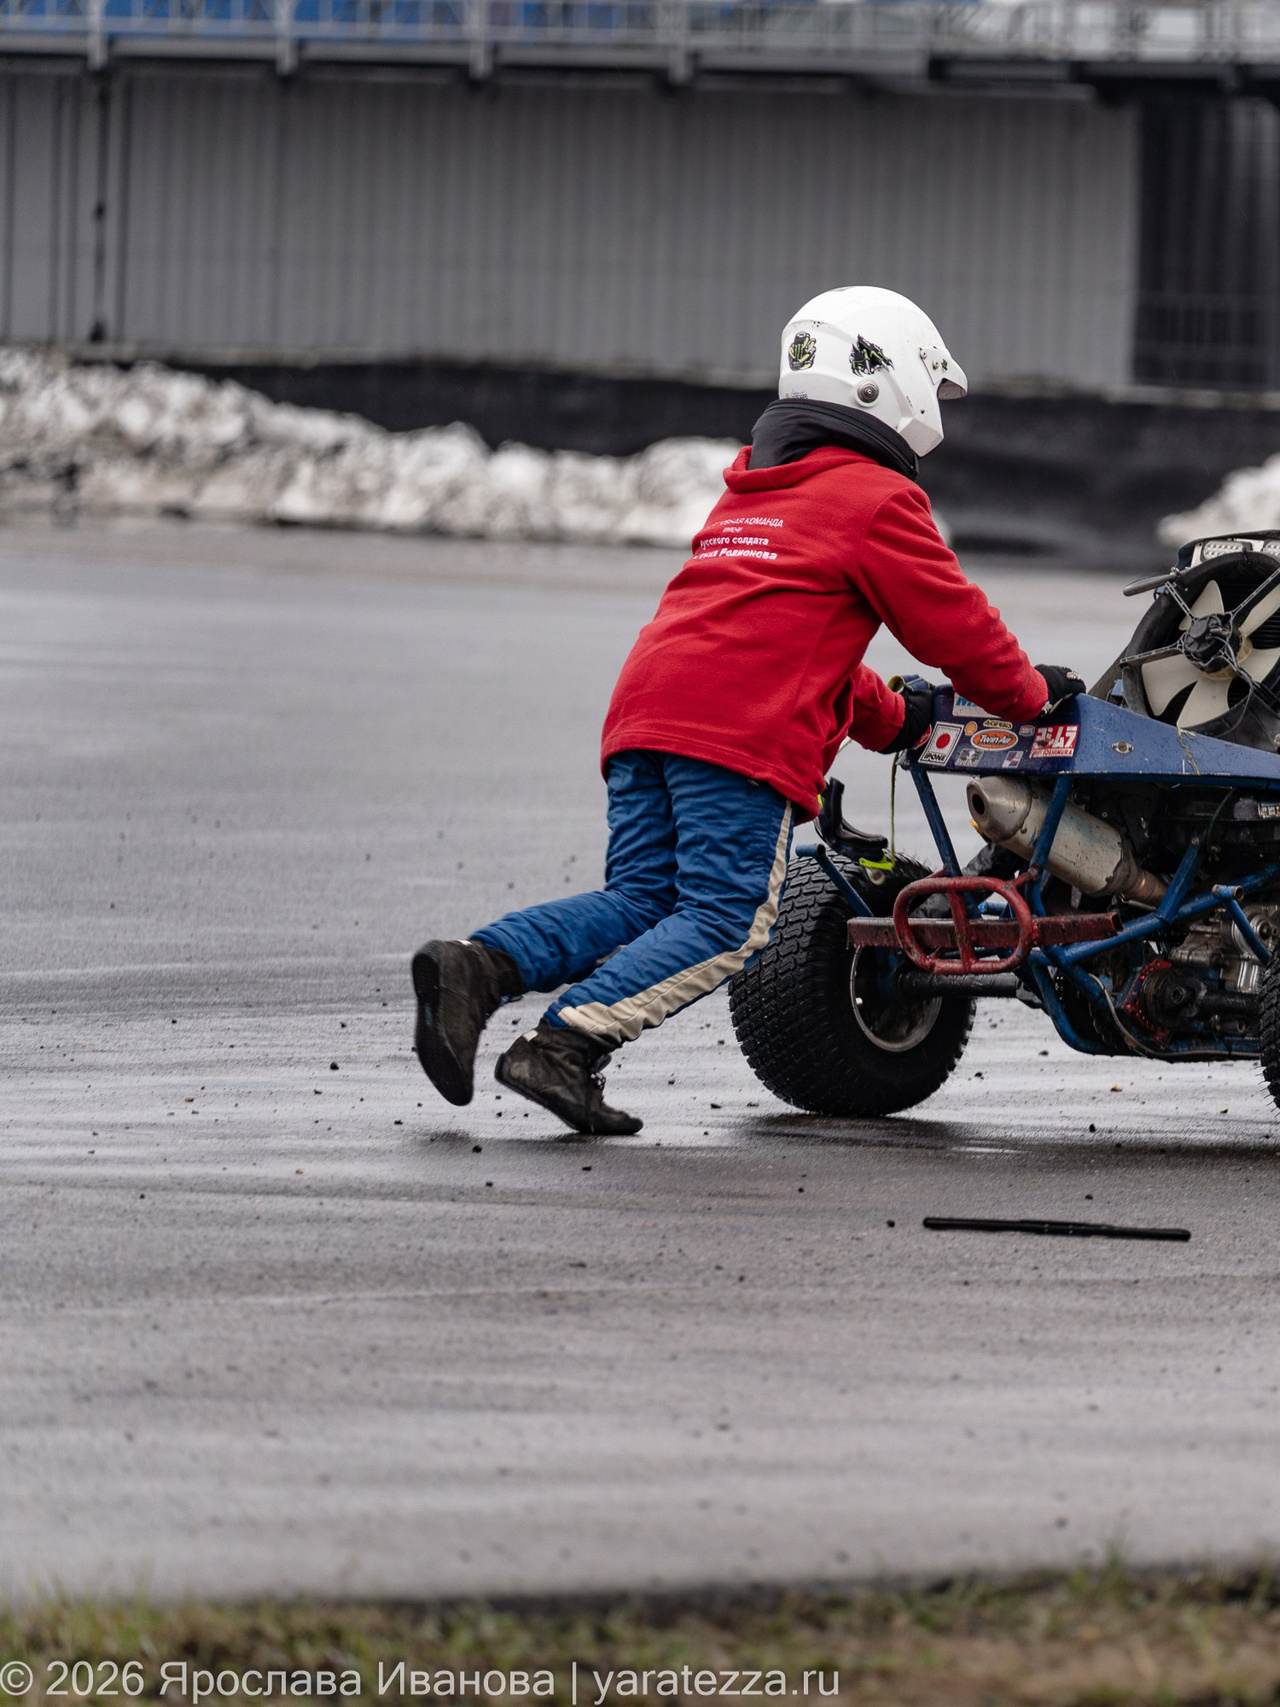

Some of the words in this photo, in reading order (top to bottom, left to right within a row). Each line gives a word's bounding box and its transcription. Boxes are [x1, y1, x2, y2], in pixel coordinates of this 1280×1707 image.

[744, 517, 784, 527] КОМАНДА
[732, 537, 769, 546] солдата
[719, 548, 777, 560] Родионова
[980, 734, 999, 744] Twin
[998, 735, 1012, 744] Air
